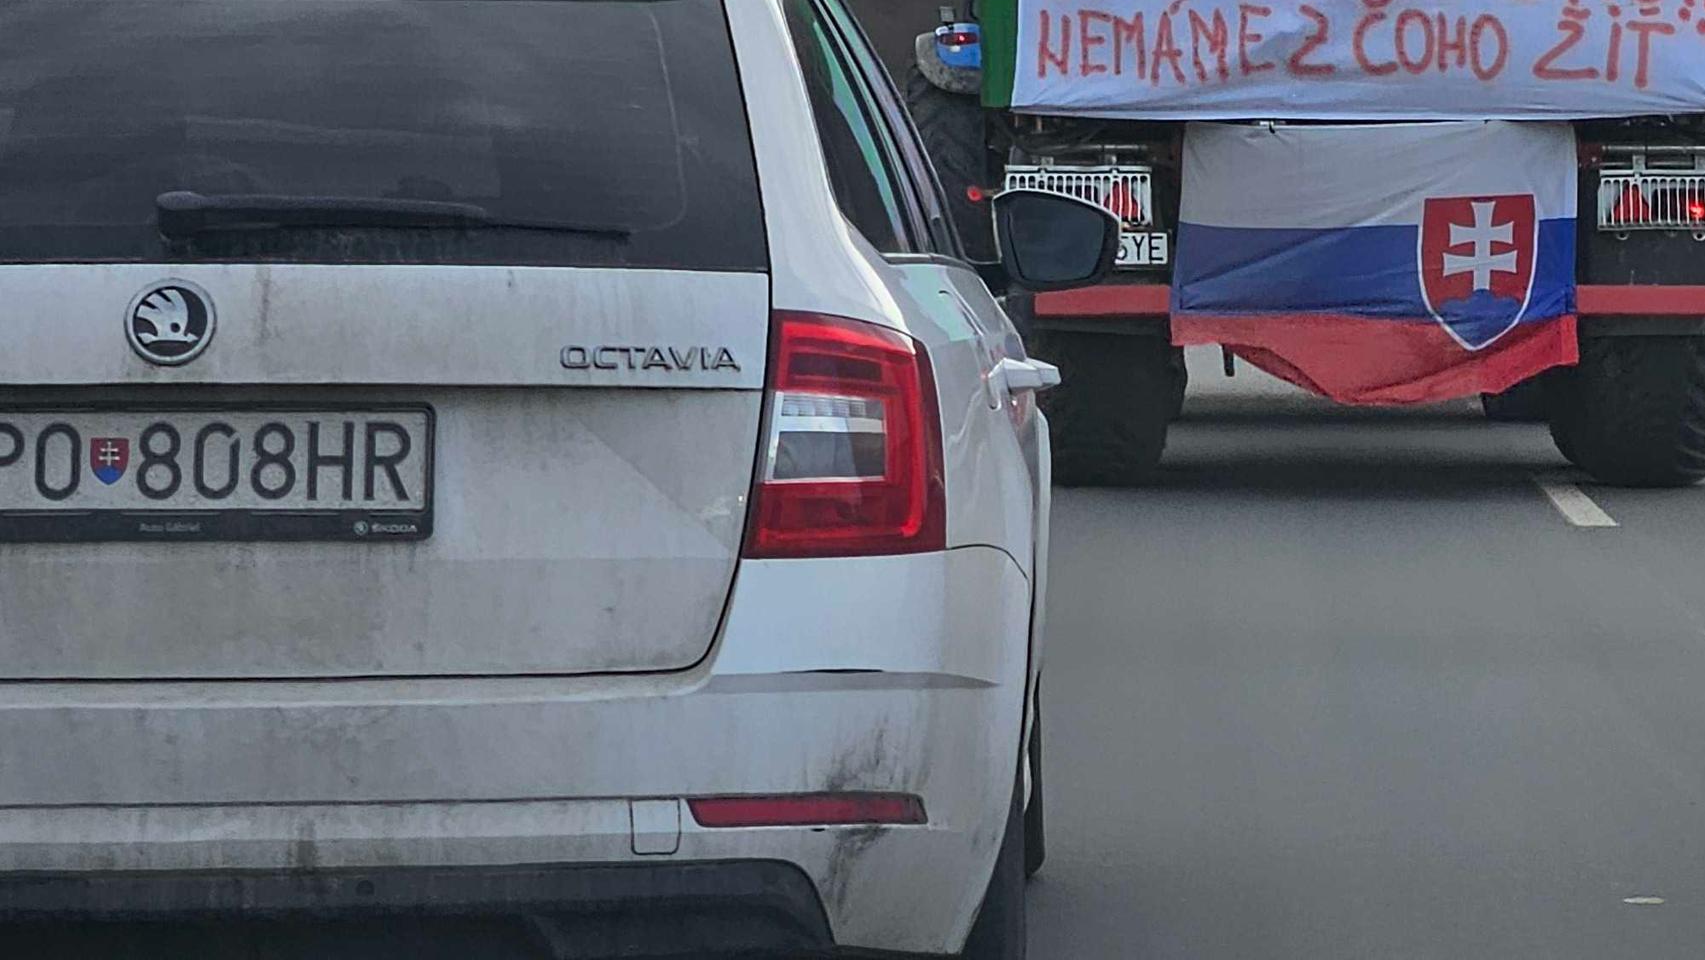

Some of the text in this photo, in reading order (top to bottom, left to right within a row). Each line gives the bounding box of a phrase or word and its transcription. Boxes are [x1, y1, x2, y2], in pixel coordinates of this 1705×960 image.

[1287, 2, 1337, 78] Z
[560, 345, 741, 372] OCTAVIA
[136, 421, 411, 501] 808HR
